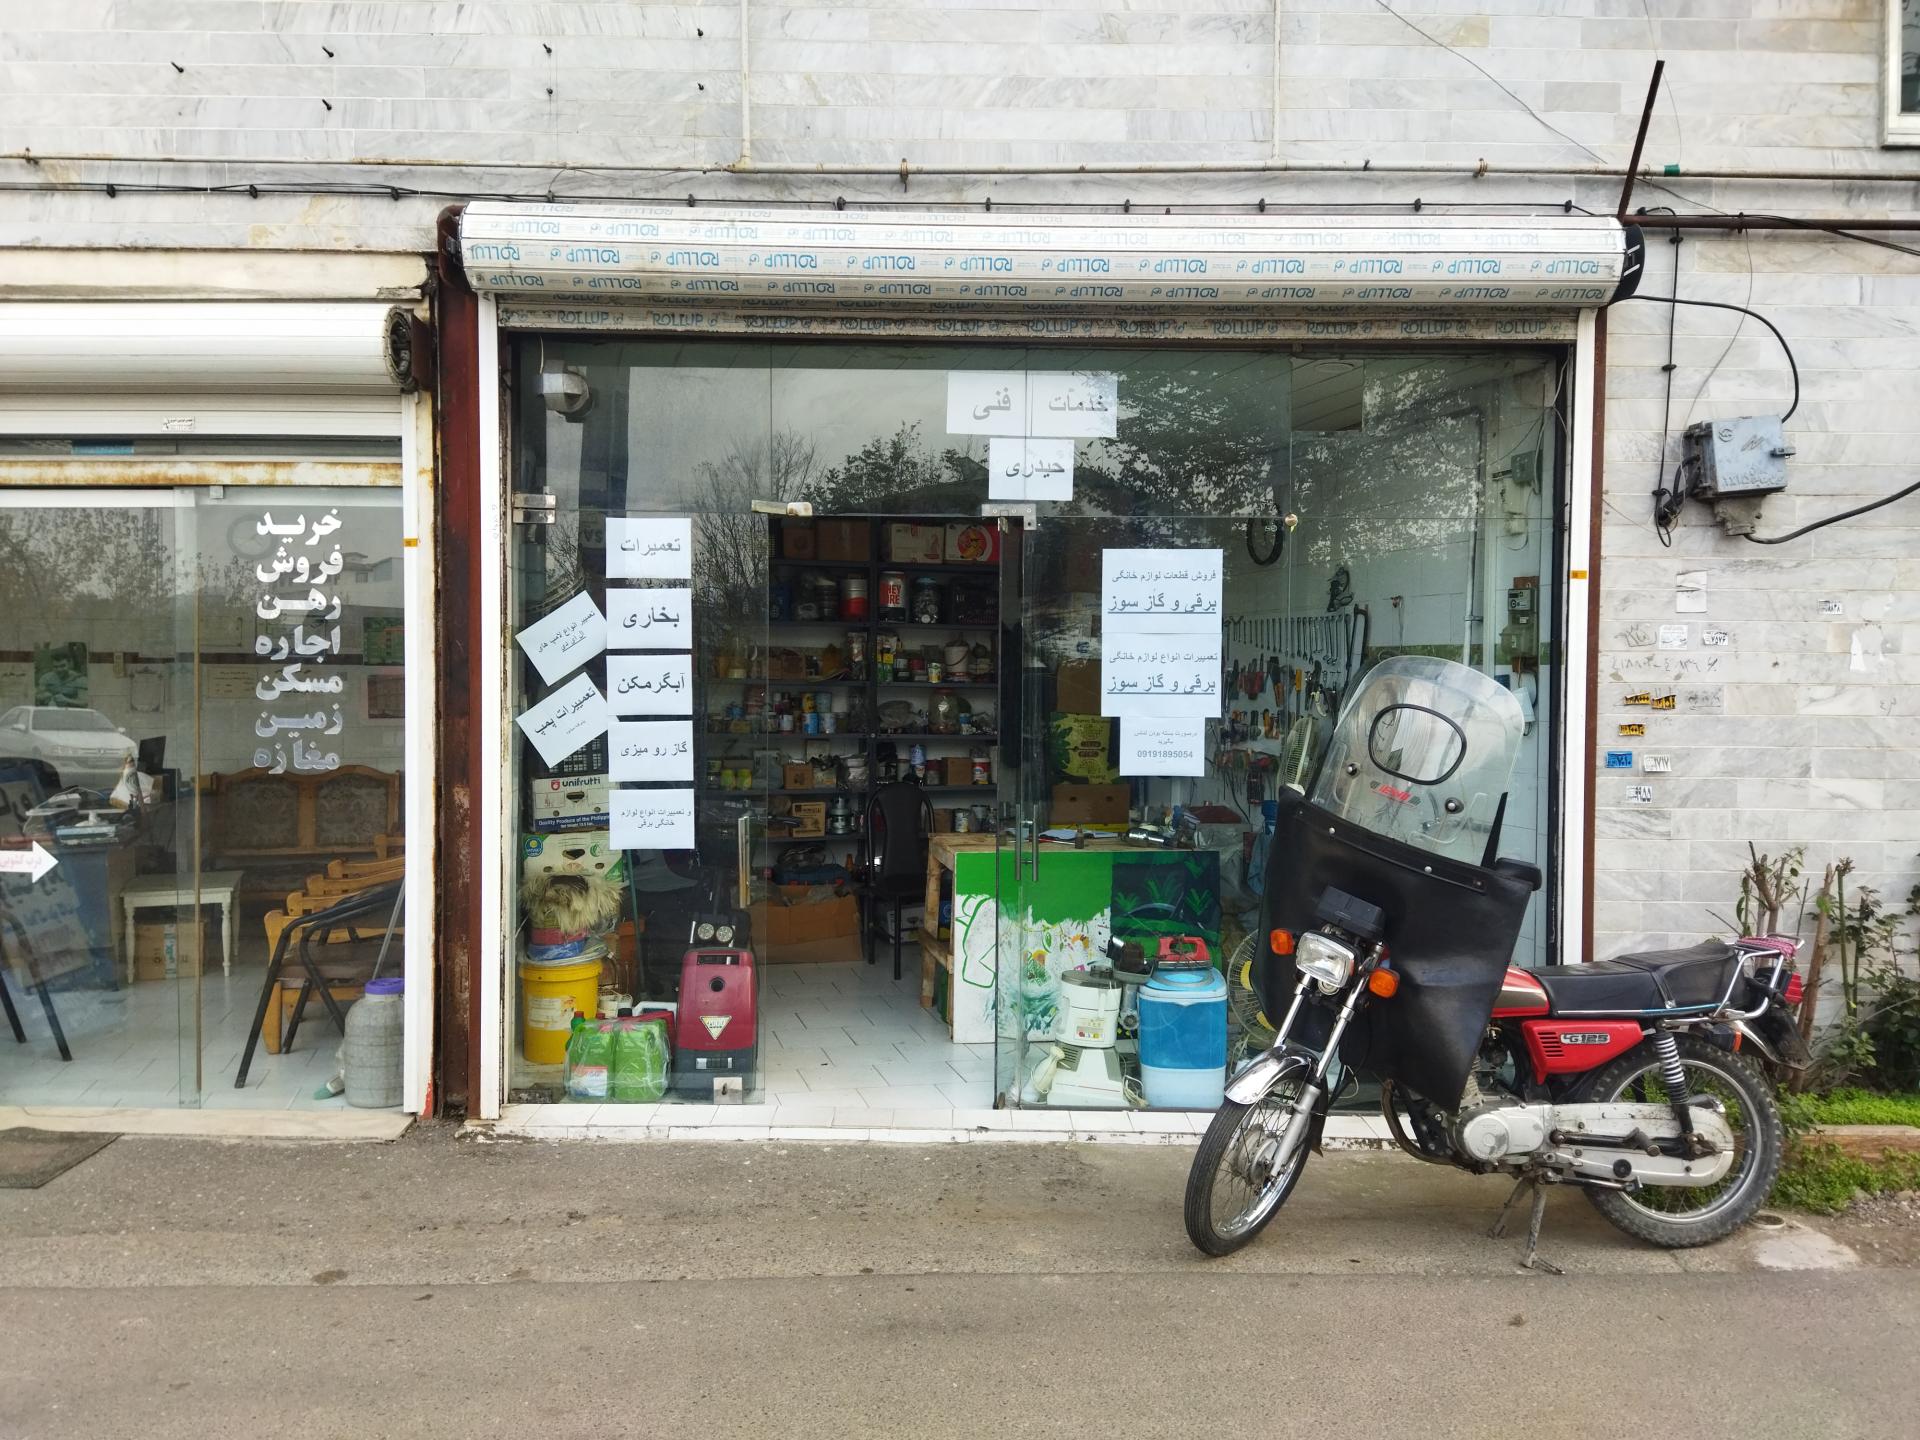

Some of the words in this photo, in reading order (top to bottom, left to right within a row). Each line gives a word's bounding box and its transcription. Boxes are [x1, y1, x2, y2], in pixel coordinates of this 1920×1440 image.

[606, 223, 659, 237] ROLLUP
[705, 226, 757, 240] ROLLUP
[803, 229, 856, 242] ROLLUP
[567, 248, 620, 264] ROLLUP
[666, 251, 719, 266] ROLLUP
[765, 253, 817, 268] ROLLUP
[862, 255, 915, 269] ROLLUP
[960, 256, 1012, 271] ROLLUP
[1057, 258, 1110, 272] ROLLUP
[1154, 259, 1207, 273] ROLLUP
[1252, 259, 1305, 273] ROLLUP
[1350, 260, 1402, 274] ROLLUP
[1448, 260, 1501, 274] ROLLUP
[1546, 261, 1599, 274] ROLLUP
[490, 274, 544, 286] ROLLUP
[589, 277, 641, 289] ROLLUP
[686, 279, 738, 291] ROLLUP
[783, 282, 835, 293] ROLLUP
[879, 283, 931, 295] ROLLUP
[975, 285, 1027, 297] ROLLUP
[1070, 286, 1123, 298] ROLLUP
[1166, 287, 1218, 298] ROLLUP
[1261, 287, 1315, 298] ROLLUP
[1358, 288, 1411, 299] ROLLUP
[1455, 288, 1510, 299] ROLLUP
[1552, 289, 1606, 300] ROLLUP
[558, 310, 609, 324] ROLLUP
[652, 313, 703, 326] ROLLUP
[1026, 320, 1079, 333] ROLLUP
[1213, 321, 1265, 334] ROLLUP
[1307, 322, 1358, 333] ROLLUP
[1400, 322, 1452, 333] ROLLUP
[1495, 322, 1546, 333] ROLLUP
[973, 387, 1011, 420] فنی
[1049, 387, 1109, 412] خدمات
[1006, 459, 1065, 478] حیدری
[256, 509, 342, 545] خرید
[621, 538, 680, 556] تعمیرات
[256, 545, 343, 584] فروش
[1112, 569, 1137, 582] خانگی
[1140, 571, 1161, 581] لوازم
[1163, 570, 1188, 579] قطعات
[1191, 569, 1216, 581] فروش
[256, 588, 342, 619] رهن
[1108, 595, 1138, 611] سوز
[1144, 592, 1164, 611] گاز
[1170, 599, 1179, 611] و
[1184, 593, 1216, 612] برقی
[623, 606, 679, 628] بخاری
[255, 625, 340, 663] اجاره
[1109, 651, 1134, 663] خانگی
[1138, 652, 1157, 663] لوازم
[1160, 652, 1180, 663] انواع
[256, 663, 343, 700] مسکن
[617, 672, 685, 693] آبگرمکن
[1108, 676, 1137, 691] سوز
[1144, 674, 1163, 691] گاز
[1169, 680, 1178, 691] و
[1183, 674, 1215, 693] برقی
[256, 703, 343, 737] زمین
[534, 718, 557, 736] پمپ
[254, 740, 340, 774] مغازه
[620, 746, 648, 756] میزی
[653, 747, 666, 756] رو
[671, 741, 687, 756] گاز
[1137, 750, 1193, 758] 09191895054
[562, 776, 601, 787] unifrutti
[621, 808, 638, 817] لوازم
[640, 808, 655, 818] انواع
[638, 819, 653, 828] برقی
[655, 819, 675, 828] خانگی
